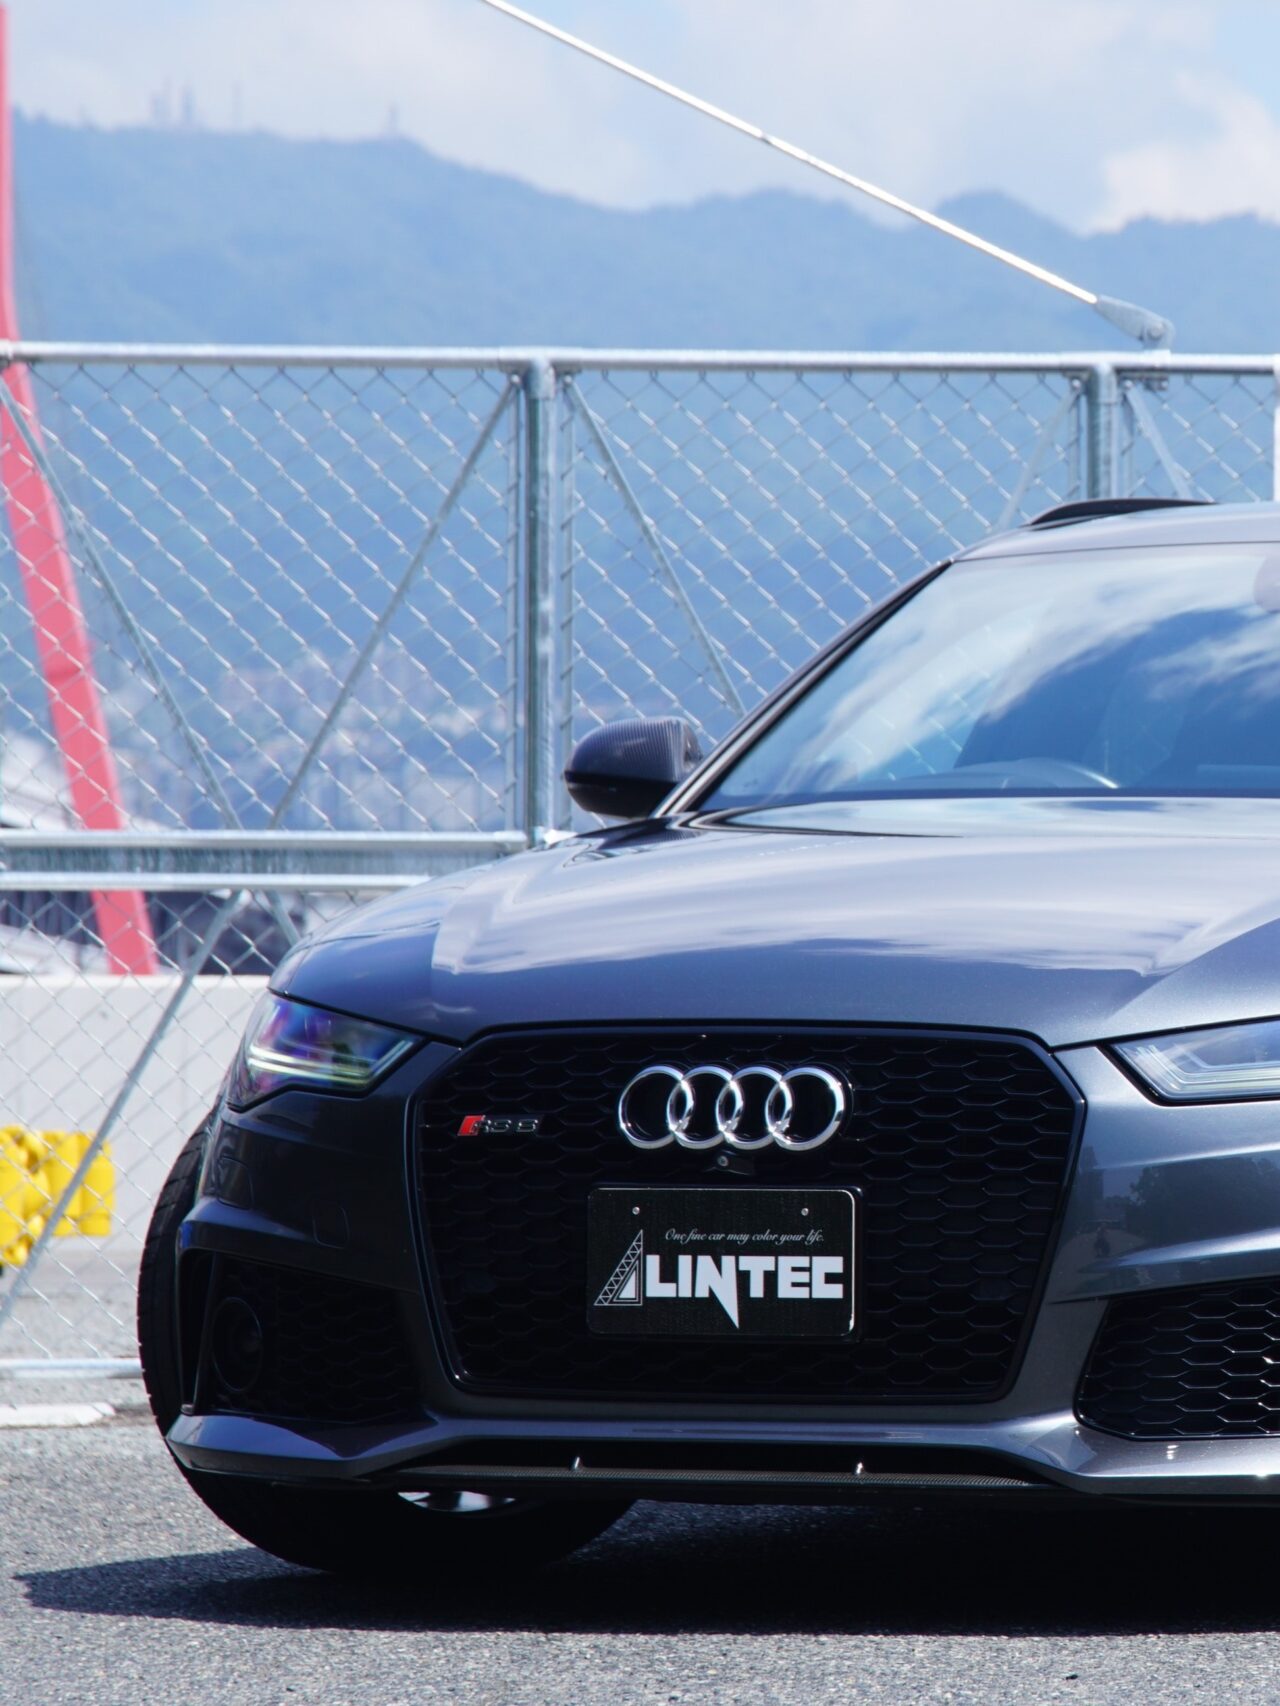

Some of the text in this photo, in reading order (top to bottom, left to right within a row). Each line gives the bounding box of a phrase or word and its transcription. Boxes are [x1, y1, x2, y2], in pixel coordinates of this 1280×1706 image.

[665, 1228, 687, 1241] One
[681, 1228, 707, 1245] fine
[708, 1233, 725, 1241] car
[727, 1233, 750, 1245] may
[752, 1228, 778, 1241] color
[775, 1234, 805, 1246] your
[646, 1255, 844, 1329] LINTEC
